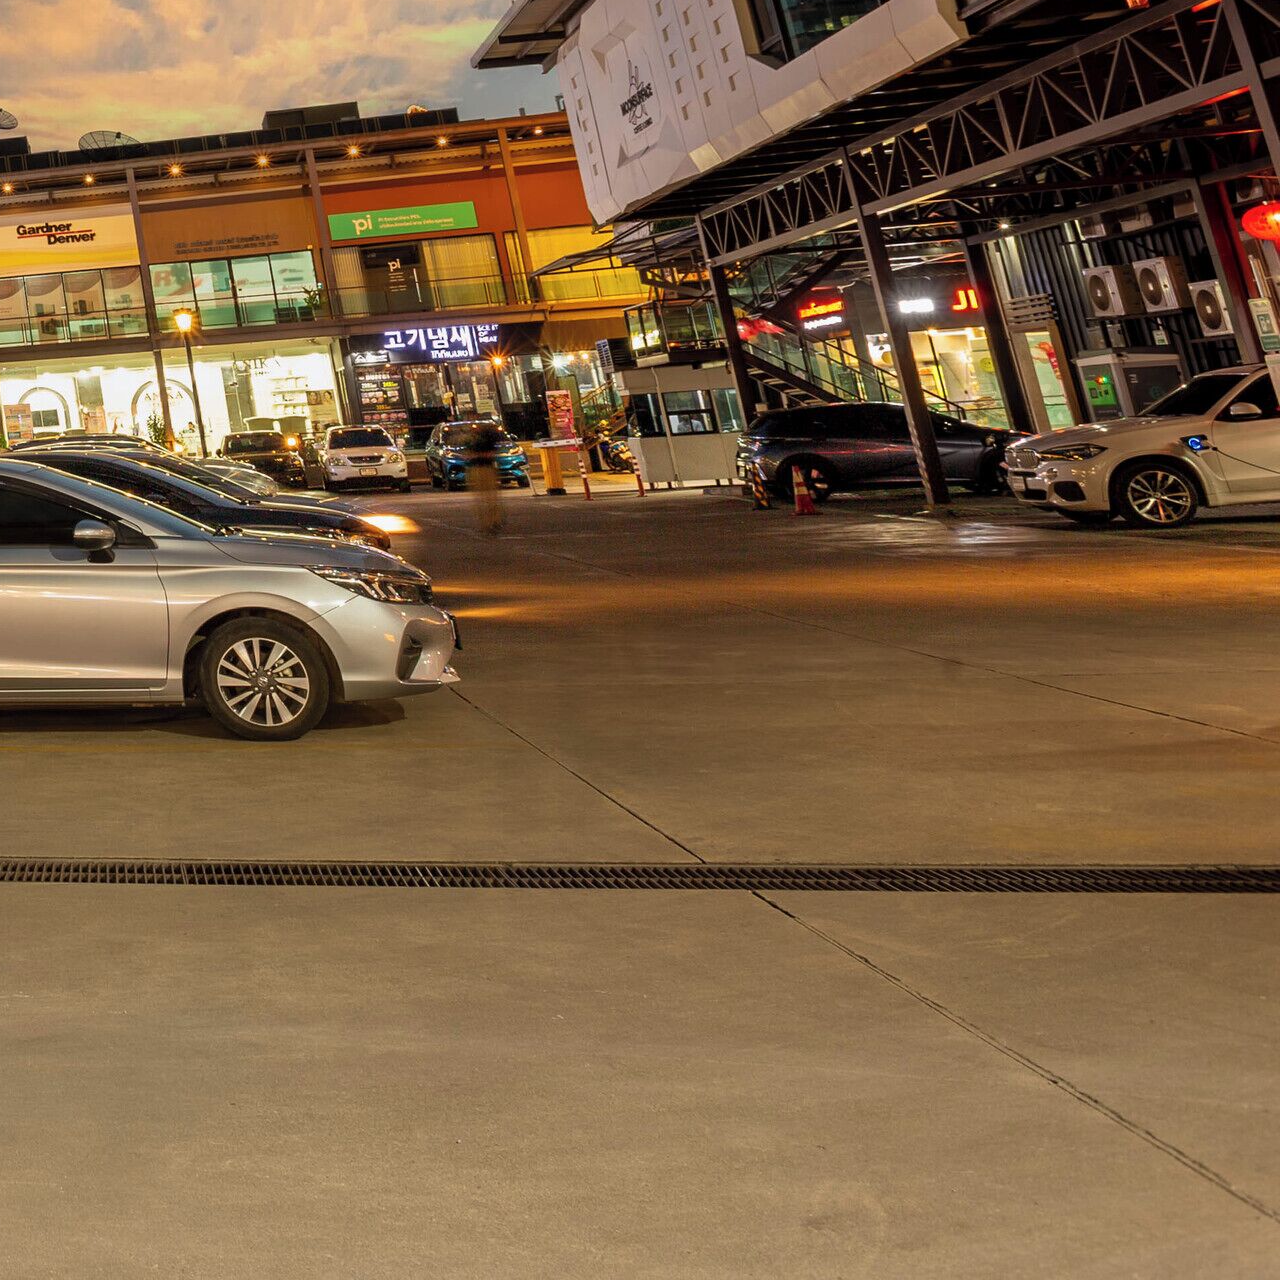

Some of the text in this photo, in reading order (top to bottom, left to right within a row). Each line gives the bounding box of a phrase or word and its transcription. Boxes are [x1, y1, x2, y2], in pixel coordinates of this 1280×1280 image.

[16, 222, 72, 236] Gardner
[352, 214, 373, 236] pi
[47, 232, 96, 245] Denver
[383, 324, 474, 357] 고기냄새
